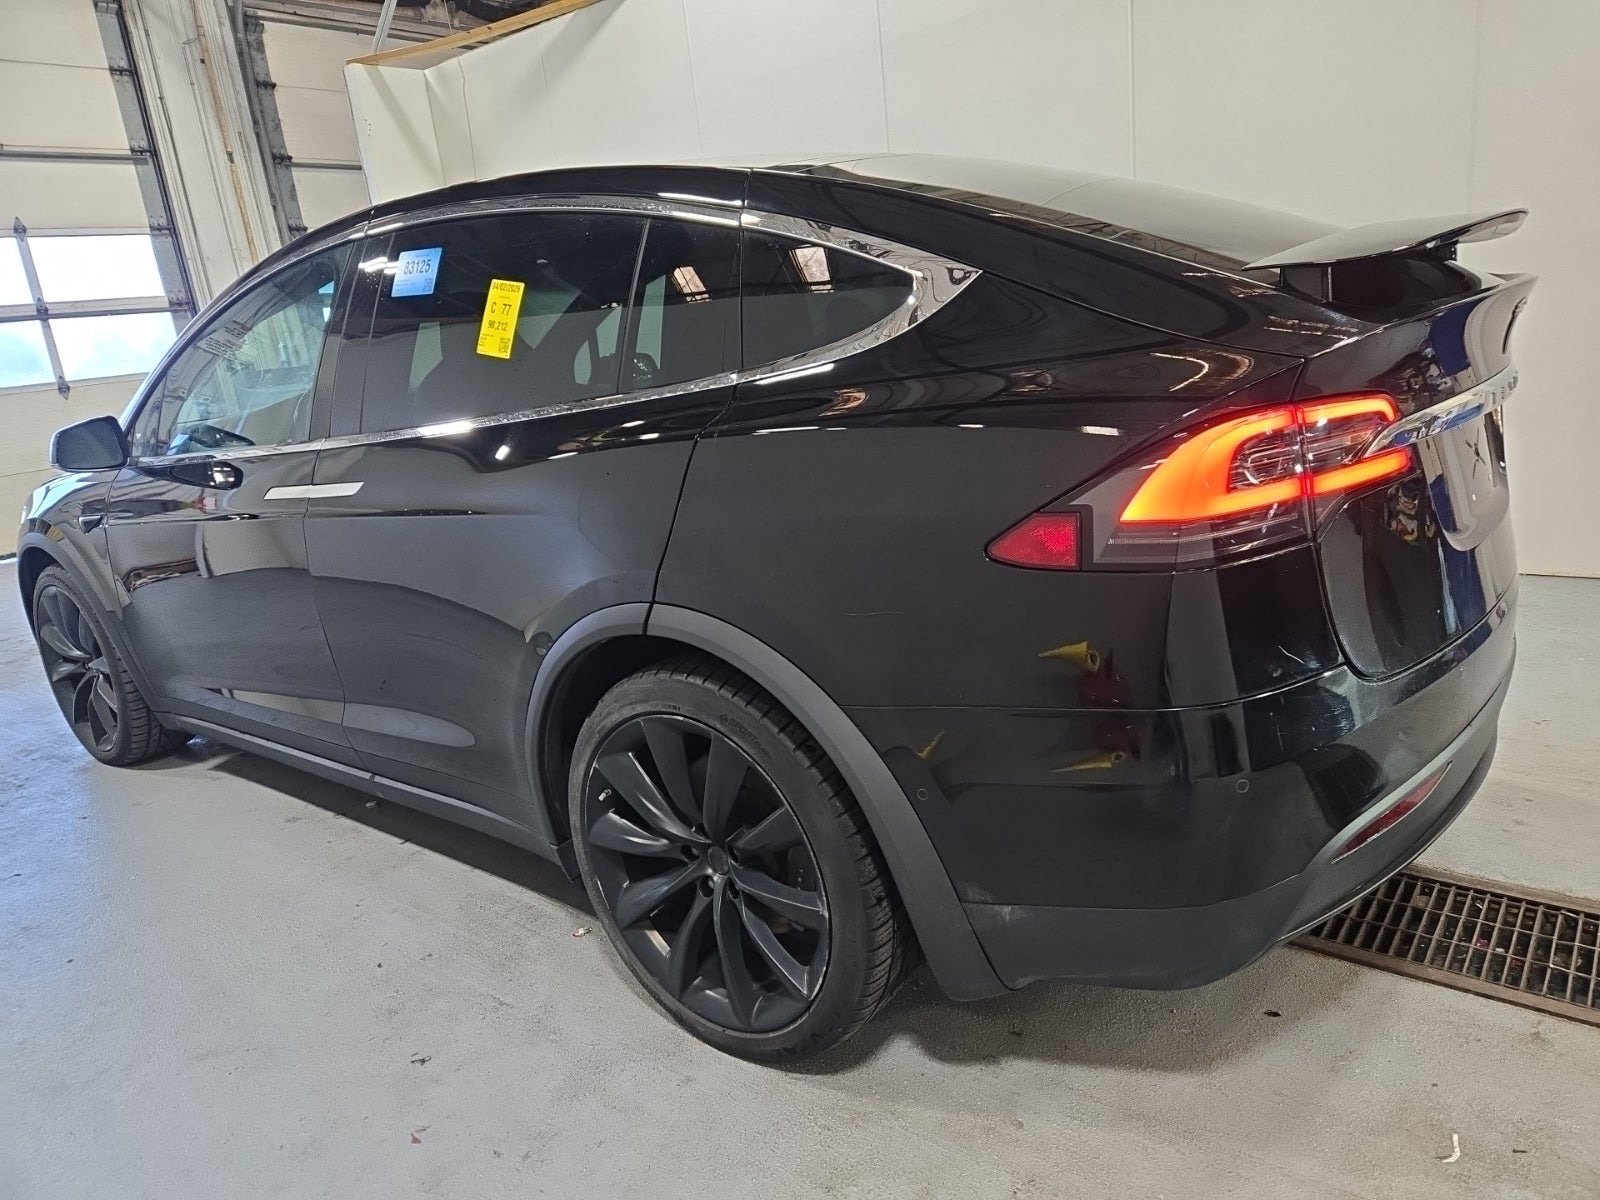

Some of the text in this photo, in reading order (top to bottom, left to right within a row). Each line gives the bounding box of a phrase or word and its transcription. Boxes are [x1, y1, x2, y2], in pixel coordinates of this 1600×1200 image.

[403, 259, 432, 275] 83125
[490, 302, 512, 316] C 77
